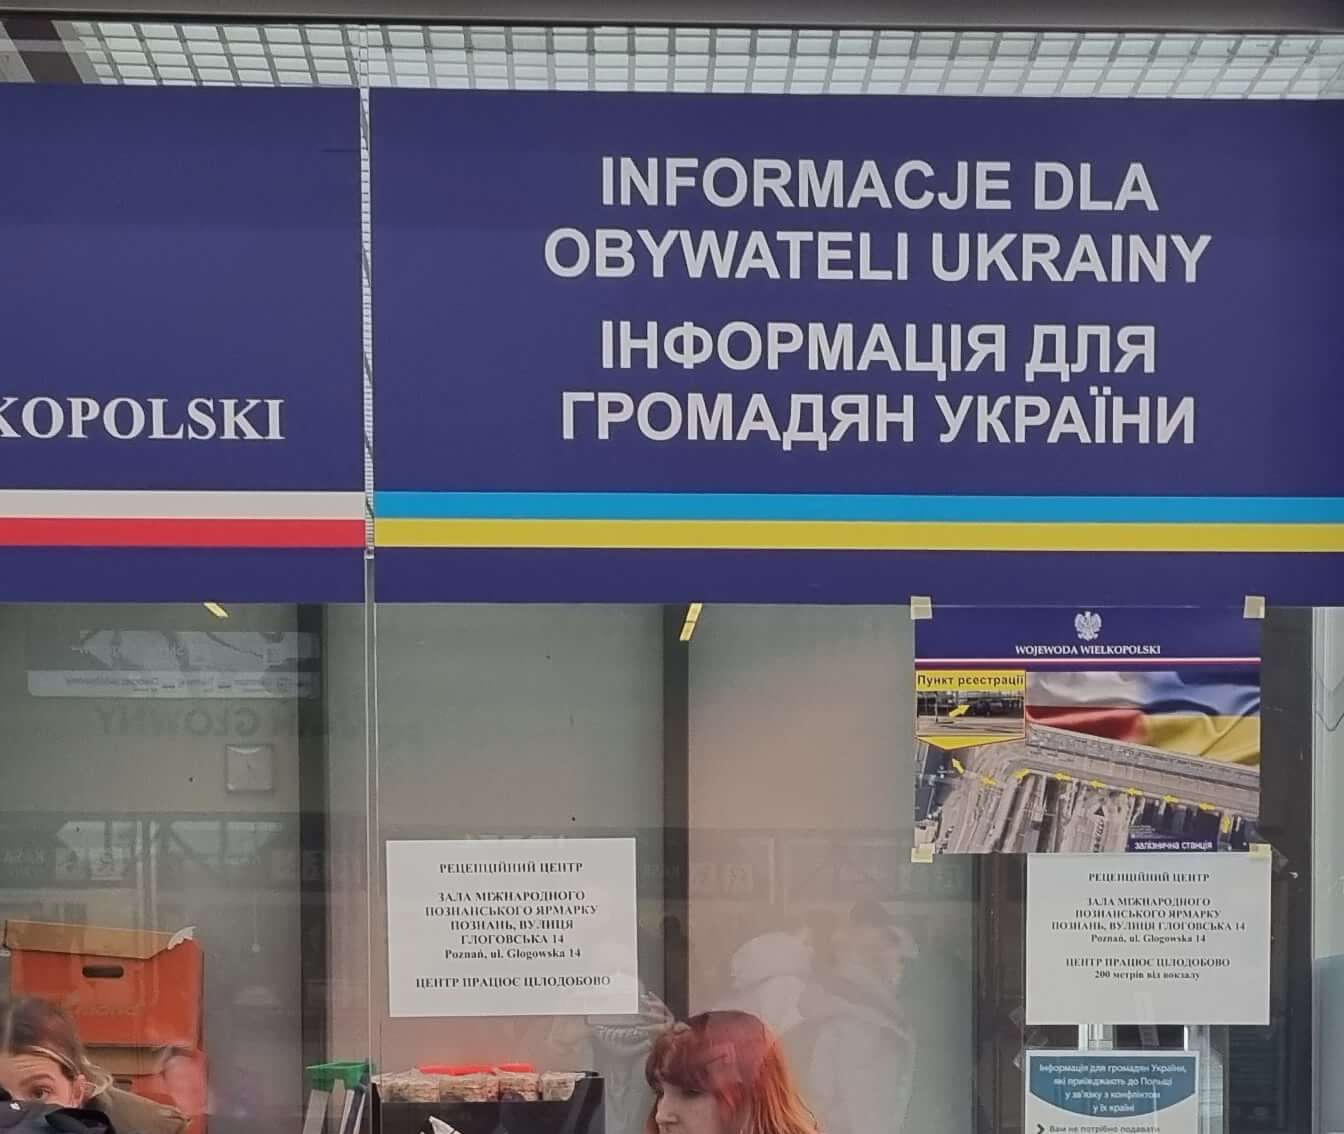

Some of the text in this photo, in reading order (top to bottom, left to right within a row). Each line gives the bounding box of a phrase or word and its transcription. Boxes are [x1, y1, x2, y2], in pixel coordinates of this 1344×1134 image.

[600, 156, 1160, 213] INFORMACJE DLA
[543, 227, 1212, 285] OBYWATELI UKRAINY
[600, 319, 1157, 385] ІНФОРМАЦІЯ ДЛЯ
[560, 387, 1195, 451] ГРОМАДЯН УКРАЇНИ
[1015, 645, 1161, 656] WOJEWODA WIELKOPOLSKI
[917, 674, 953, 688] Пункт
